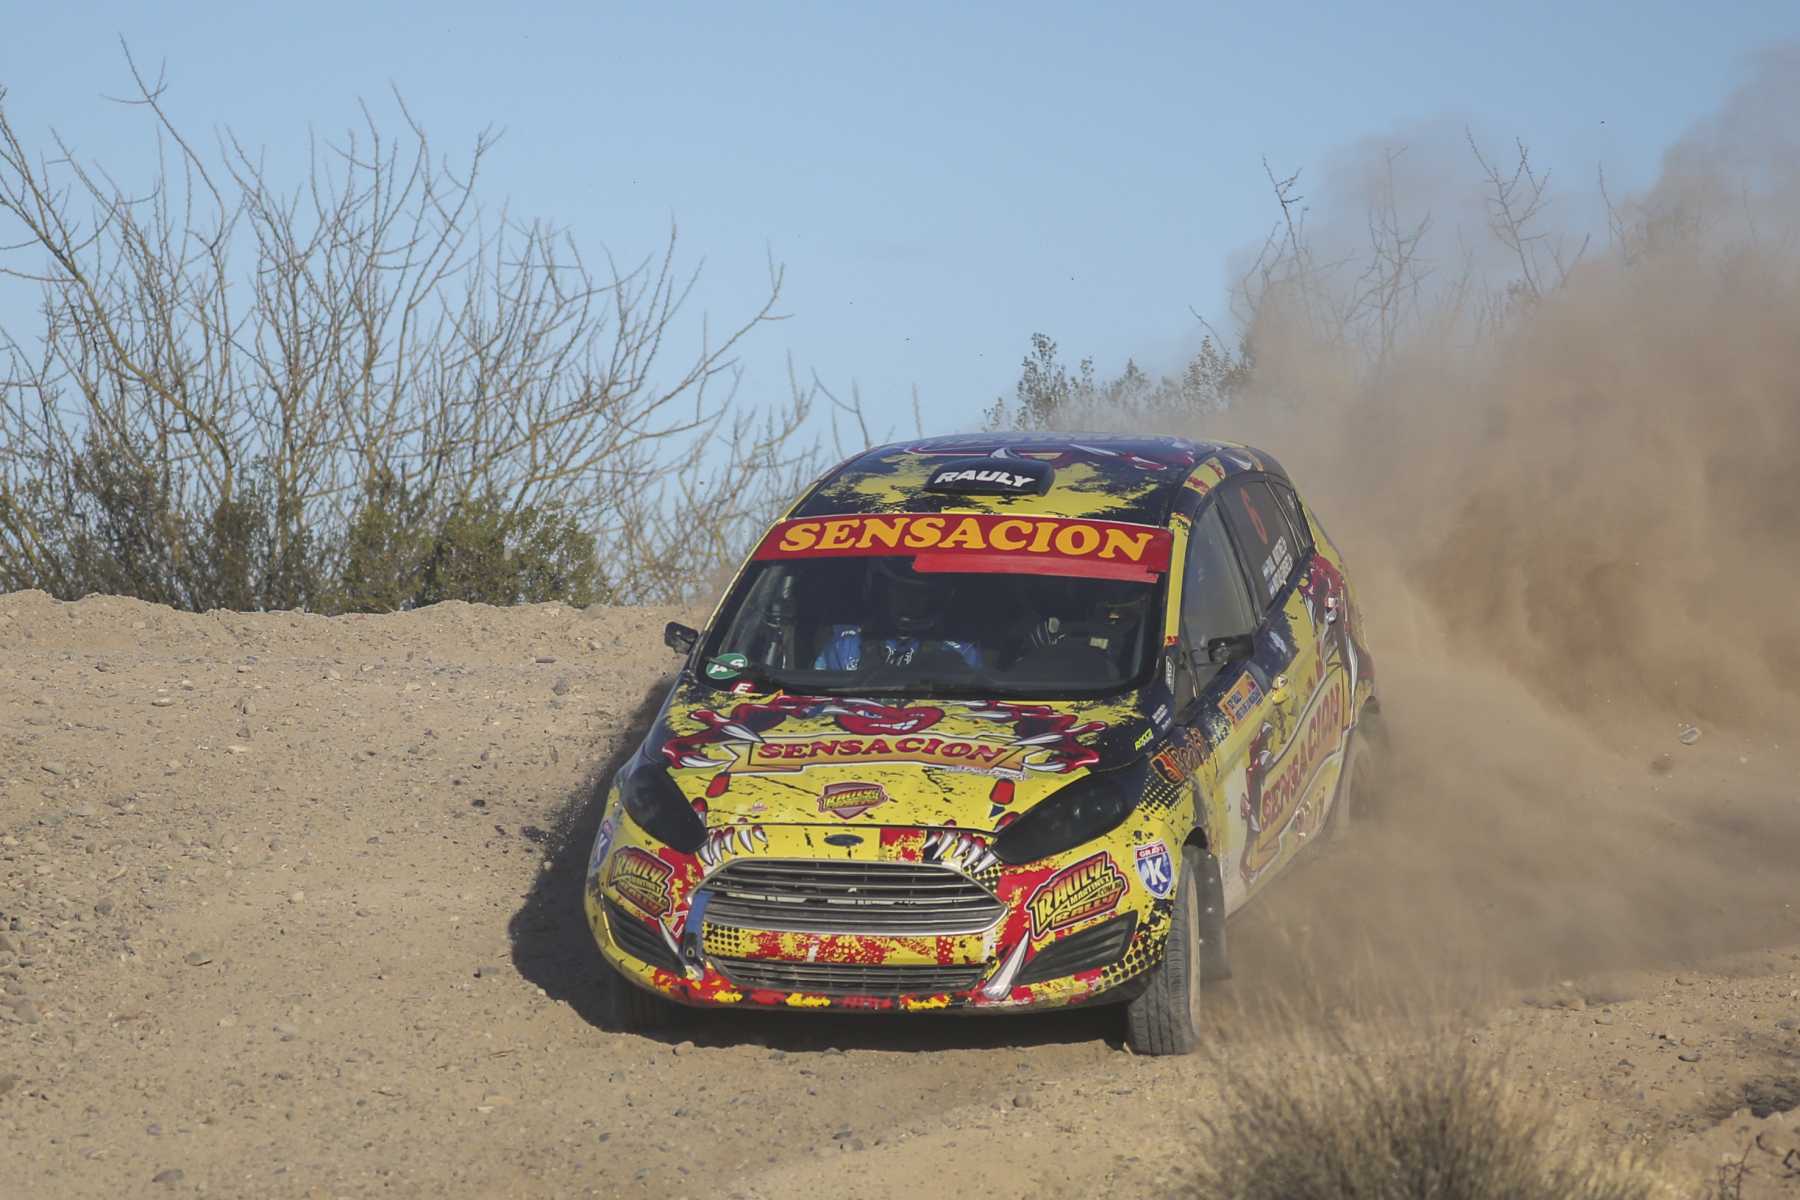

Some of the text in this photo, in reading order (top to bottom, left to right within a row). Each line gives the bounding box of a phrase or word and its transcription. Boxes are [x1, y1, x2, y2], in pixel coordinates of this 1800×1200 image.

[934, 469, 1036, 487] RAULY
[779, 518, 1154, 561] SENSACION
[757, 738, 1008, 761] SENSACION
[1145, 857, 1168, 886] K
[1038, 861, 1104, 926] RAULY
